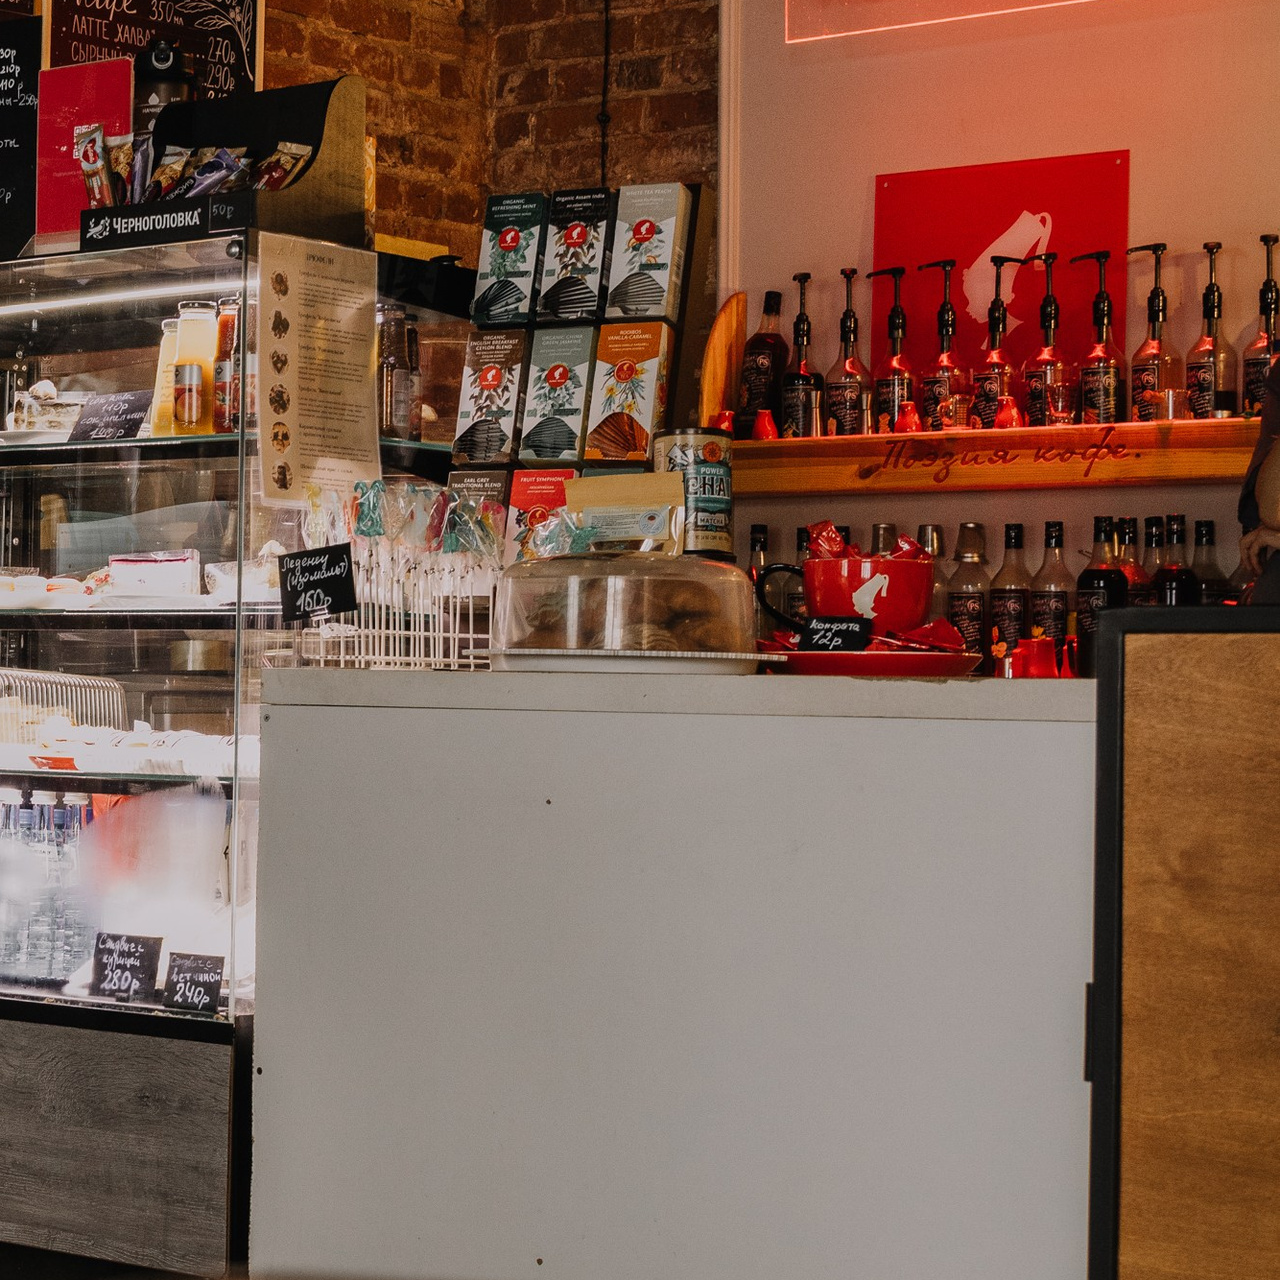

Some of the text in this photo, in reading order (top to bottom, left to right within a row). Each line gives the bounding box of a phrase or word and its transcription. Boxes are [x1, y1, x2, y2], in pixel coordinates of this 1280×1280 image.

[72, 14, 110, 41] ЛАТТЕ
[113, 210, 199, 234] ЧЕРНОГОЛОВКА
[701, 467, 724, 475] POWER
[700, 517, 724, 525] MATCHA
